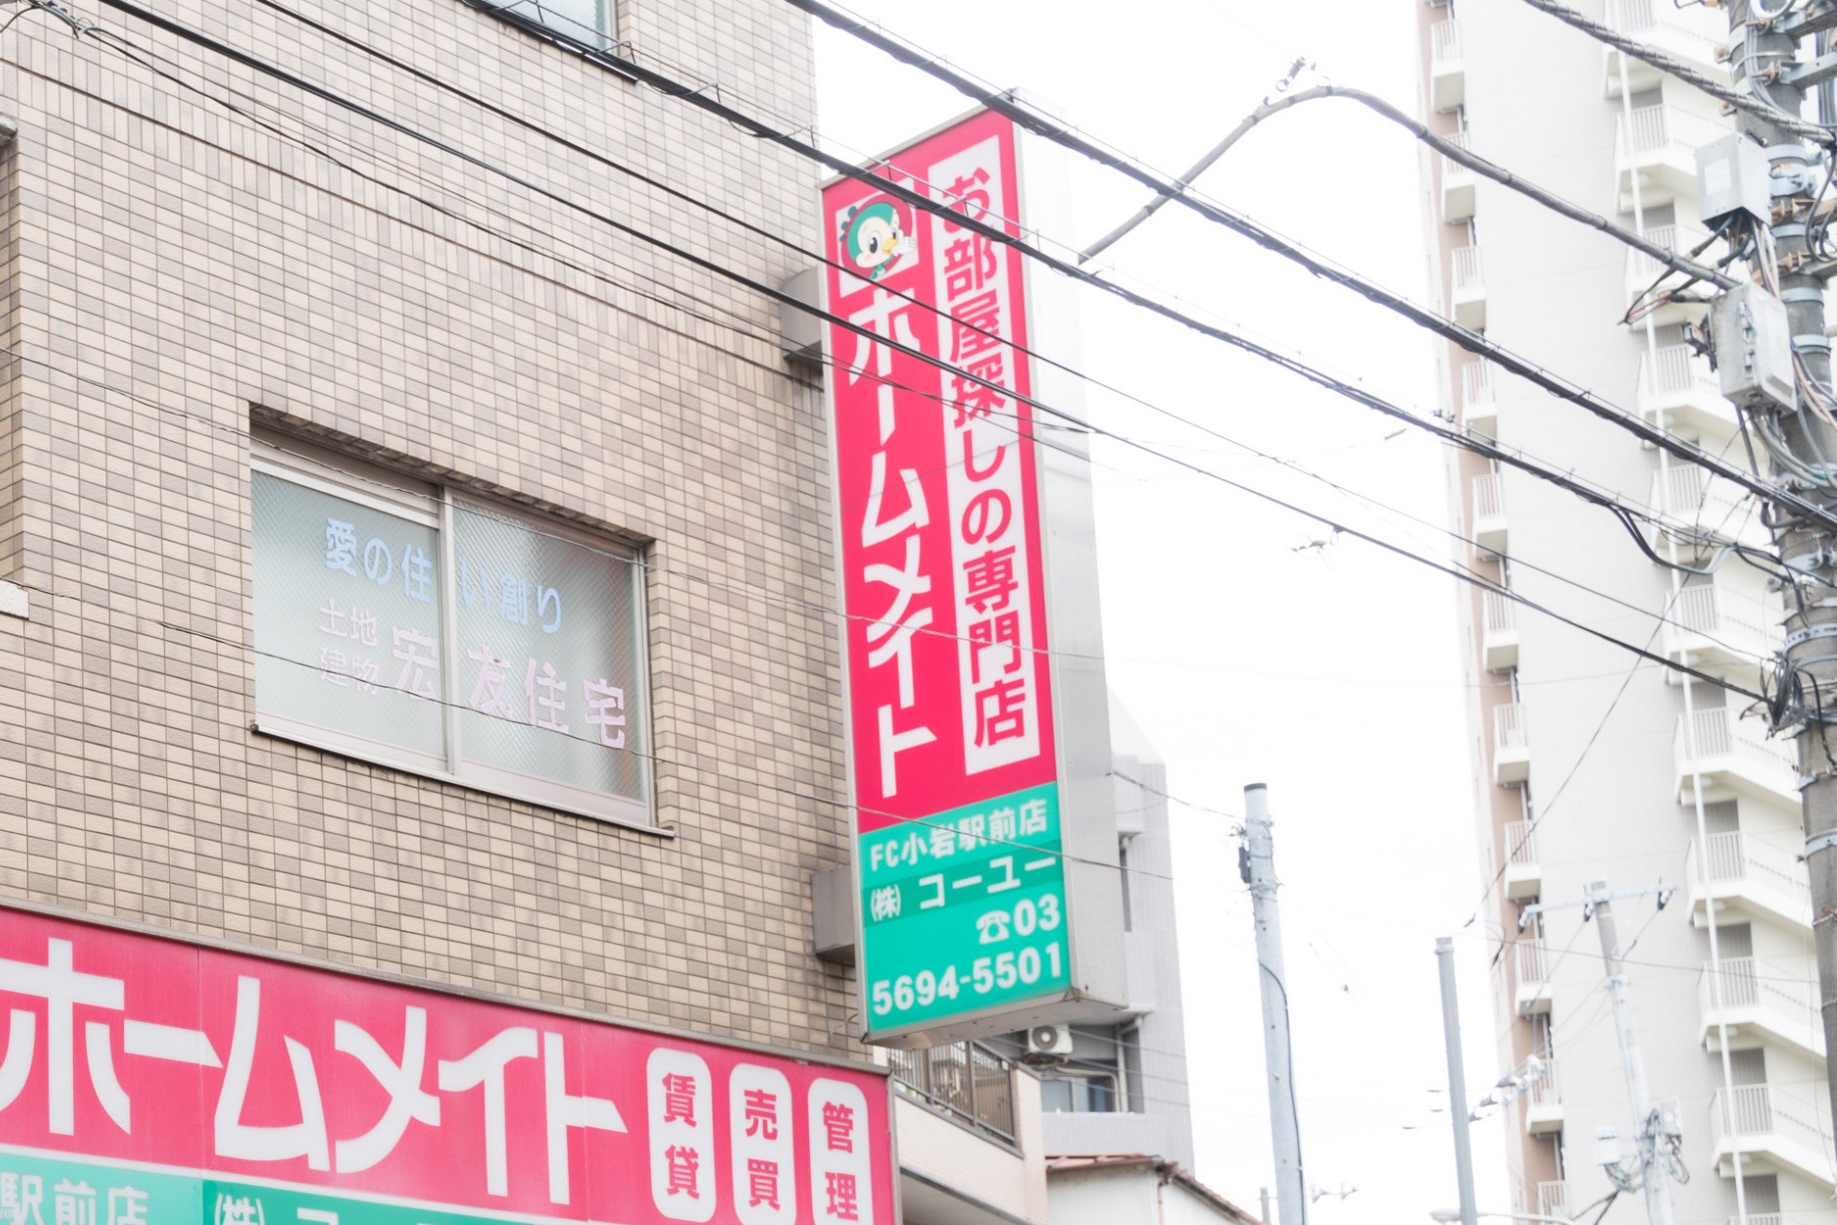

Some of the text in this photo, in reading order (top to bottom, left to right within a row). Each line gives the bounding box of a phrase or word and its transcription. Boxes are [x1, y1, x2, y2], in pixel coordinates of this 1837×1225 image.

[942, 166, 1026, 749] お部屋探しの専門店
[848, 287, 937, 798] ホームメイト
[871, 799, 1048, 872] FC小岩駅前店
[918, 854, 1056, 910] コーユー
[1014, 893, 1061, 936] 03
[872, 941, 1062, 1015] 5694-5501
[662, 1073, 700, 1200] 賃貸
[743, 1088, 781, 1211] 売買
[822, 1101, 859, 1222] 管理
